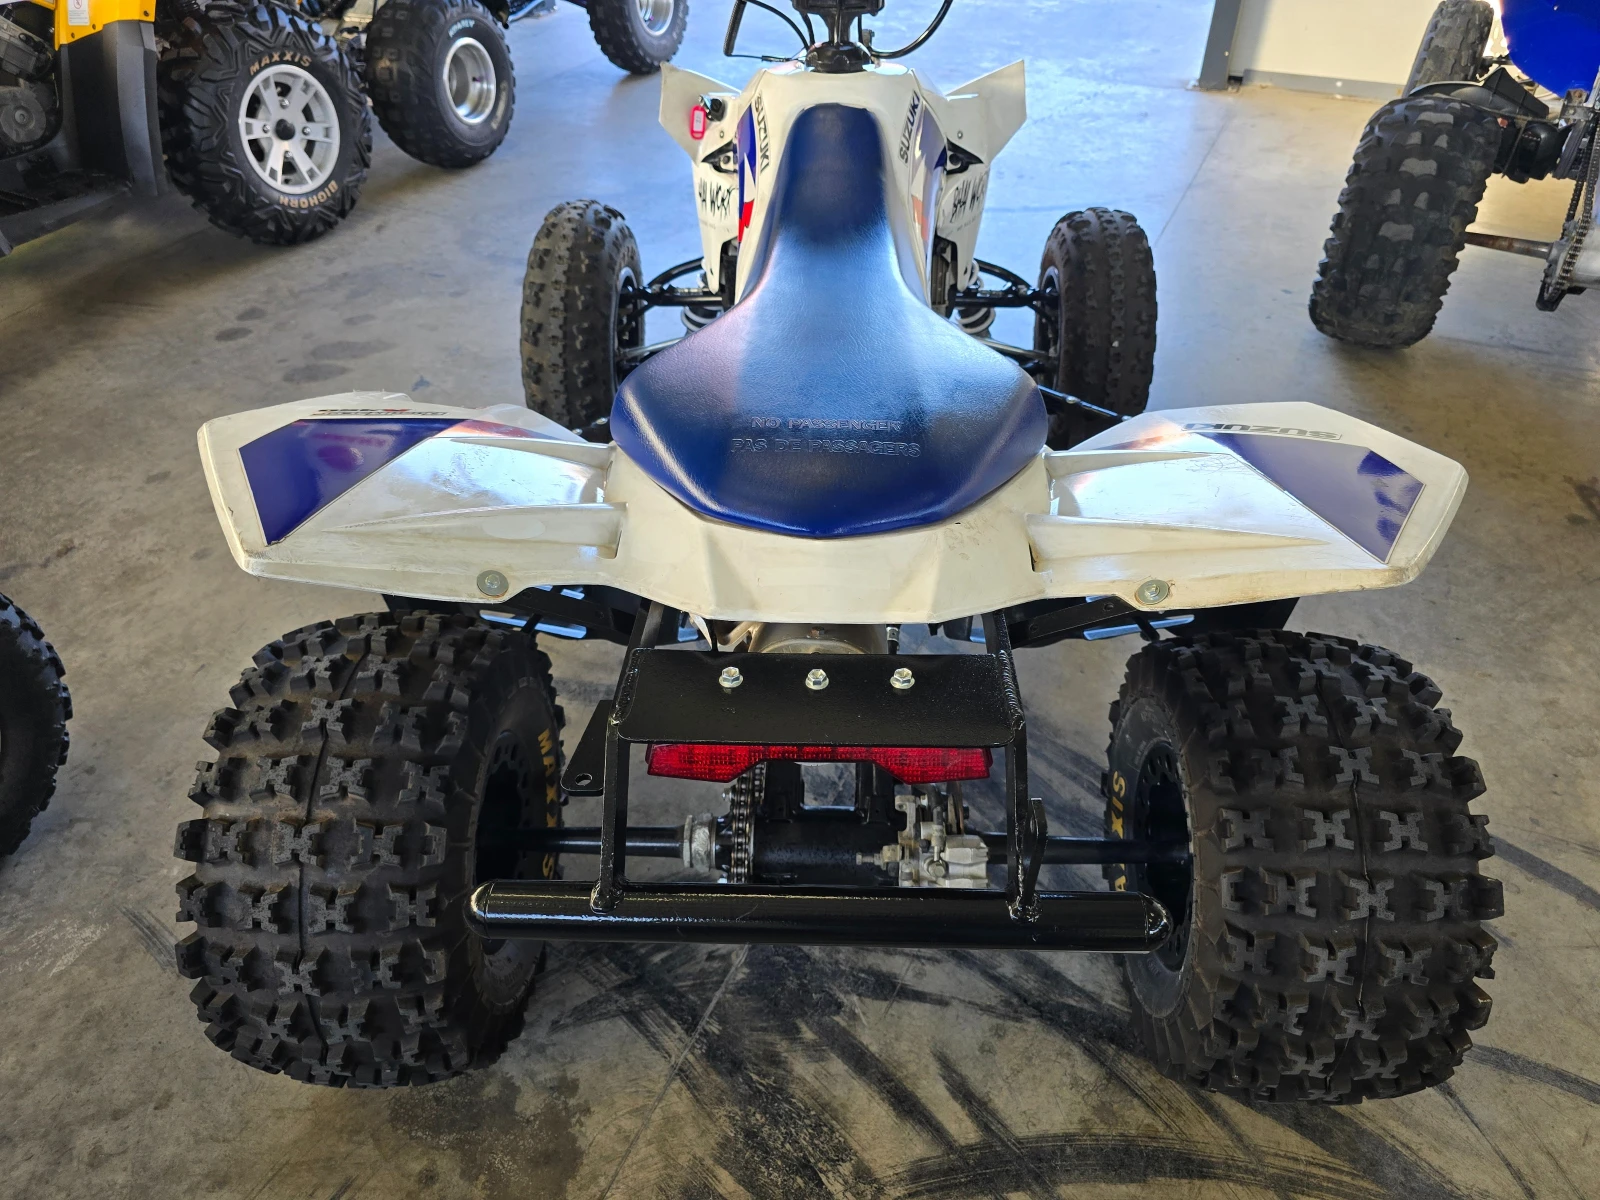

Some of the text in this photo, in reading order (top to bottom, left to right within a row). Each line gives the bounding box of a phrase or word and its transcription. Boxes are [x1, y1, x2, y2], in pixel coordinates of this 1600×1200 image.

[249, 49, 312, 76] MAXXIS
[755, 96, 770, 174] SUZUKI
[900, 90, 921, 163] SUZUKI
[279, 180, 339, 208] BIGHORN
[751, 416, 902, 432] NO PASSENGER
[731, 438, 922, 458] PAS DE PASSAGERS
[537, 728, 558, 878] MAXXS
